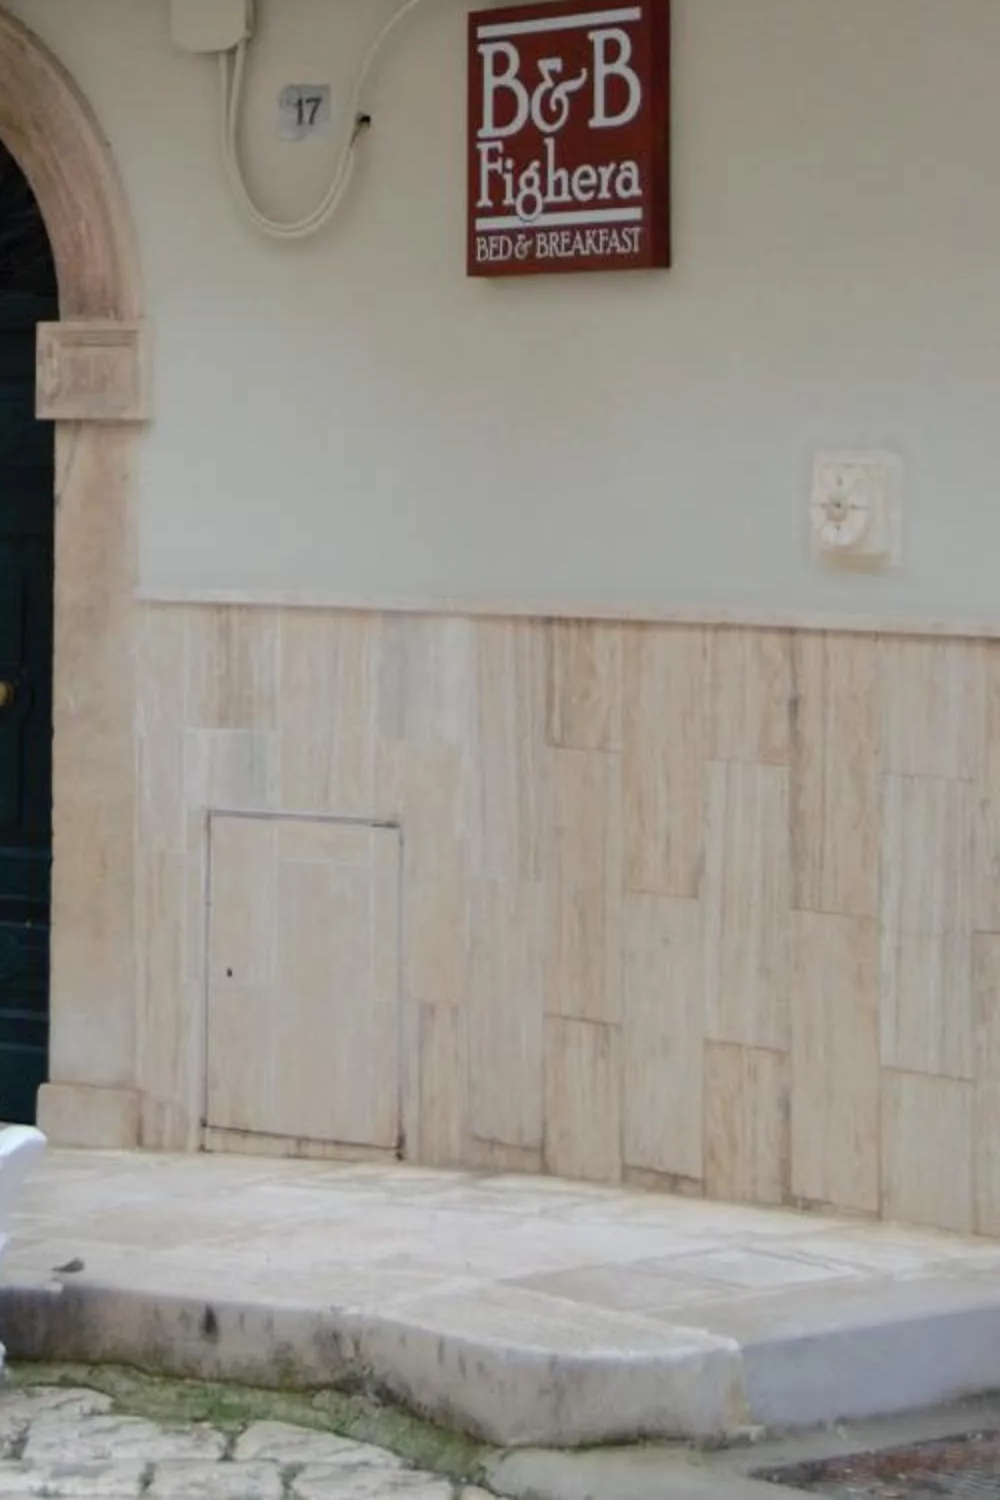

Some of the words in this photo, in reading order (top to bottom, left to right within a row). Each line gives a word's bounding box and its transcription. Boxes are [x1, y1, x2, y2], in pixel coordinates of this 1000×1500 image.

[296, 97, 322, 126] 17
[477, 29, 642, 138] B&B
[476, 139, 642, 221] Fighera
[535, 227, 641, 258] BREAKFAST
